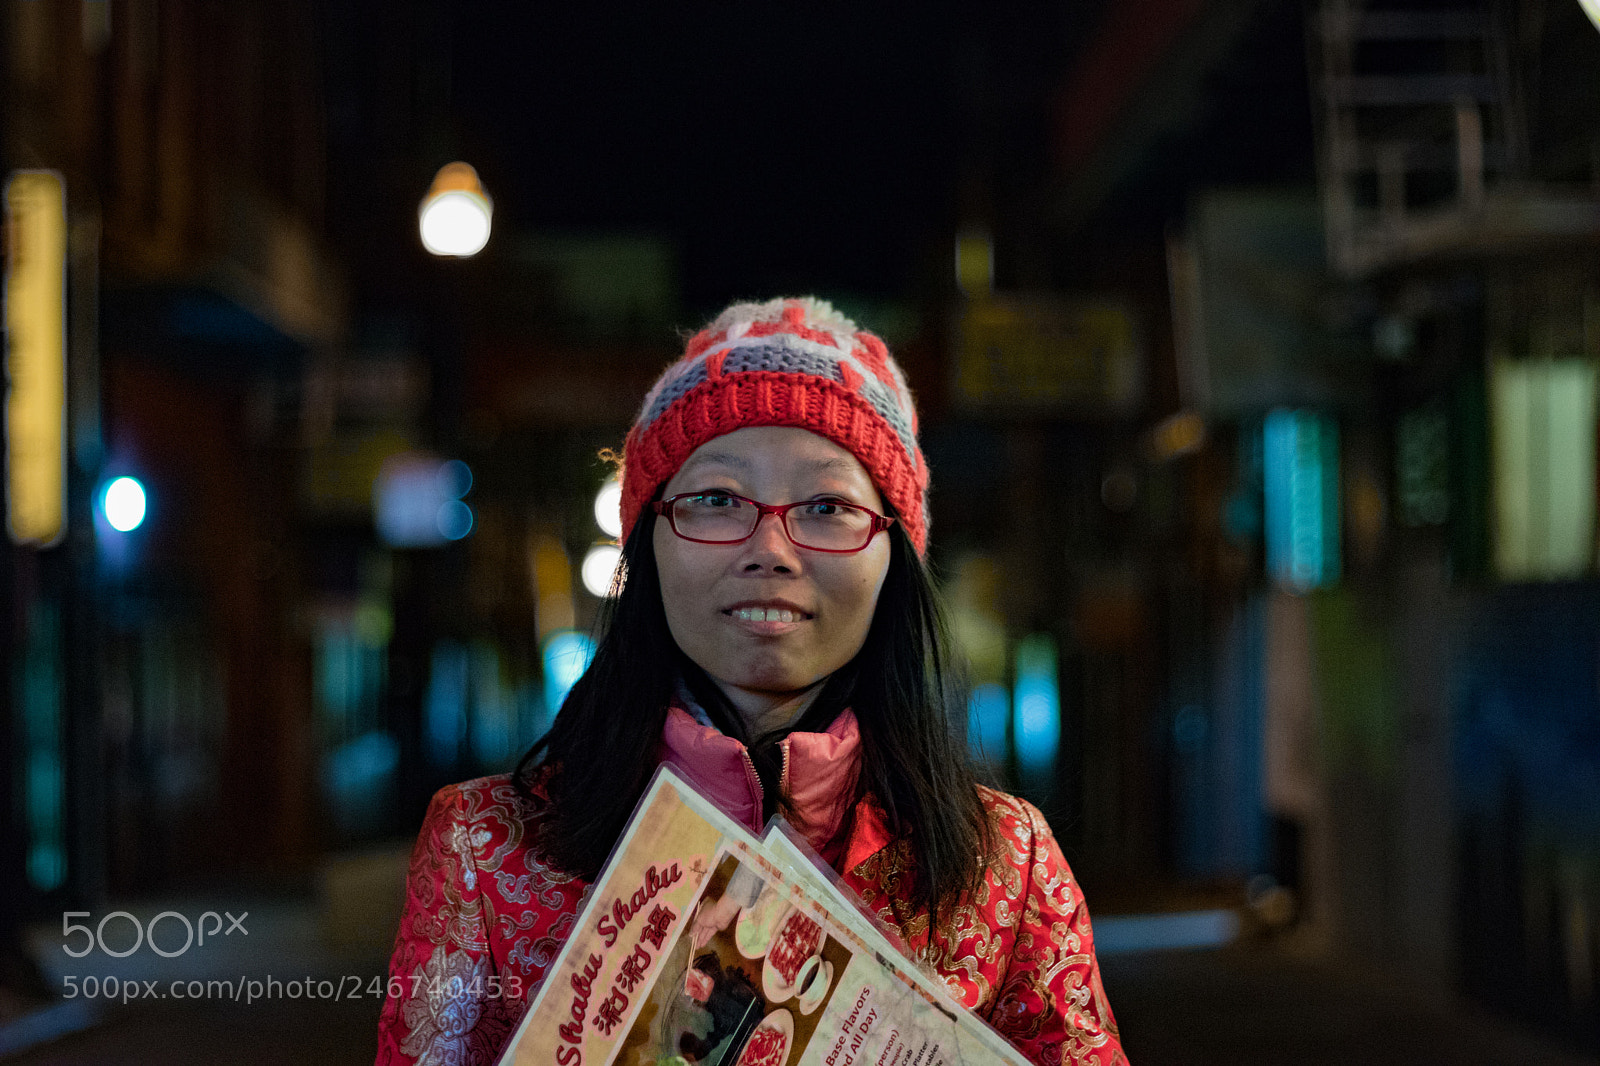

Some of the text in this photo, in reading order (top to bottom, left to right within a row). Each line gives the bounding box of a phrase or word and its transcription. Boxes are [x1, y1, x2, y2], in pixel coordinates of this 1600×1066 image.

[556, 862, 683, 1066] Shabu Shabu
[825, 986, 871, 1066] Base Flavors
[850, 1033, 864, 1055] All
[859, 1007, 878, 1034] Day
[925, 1044, 940, 1066] tables
